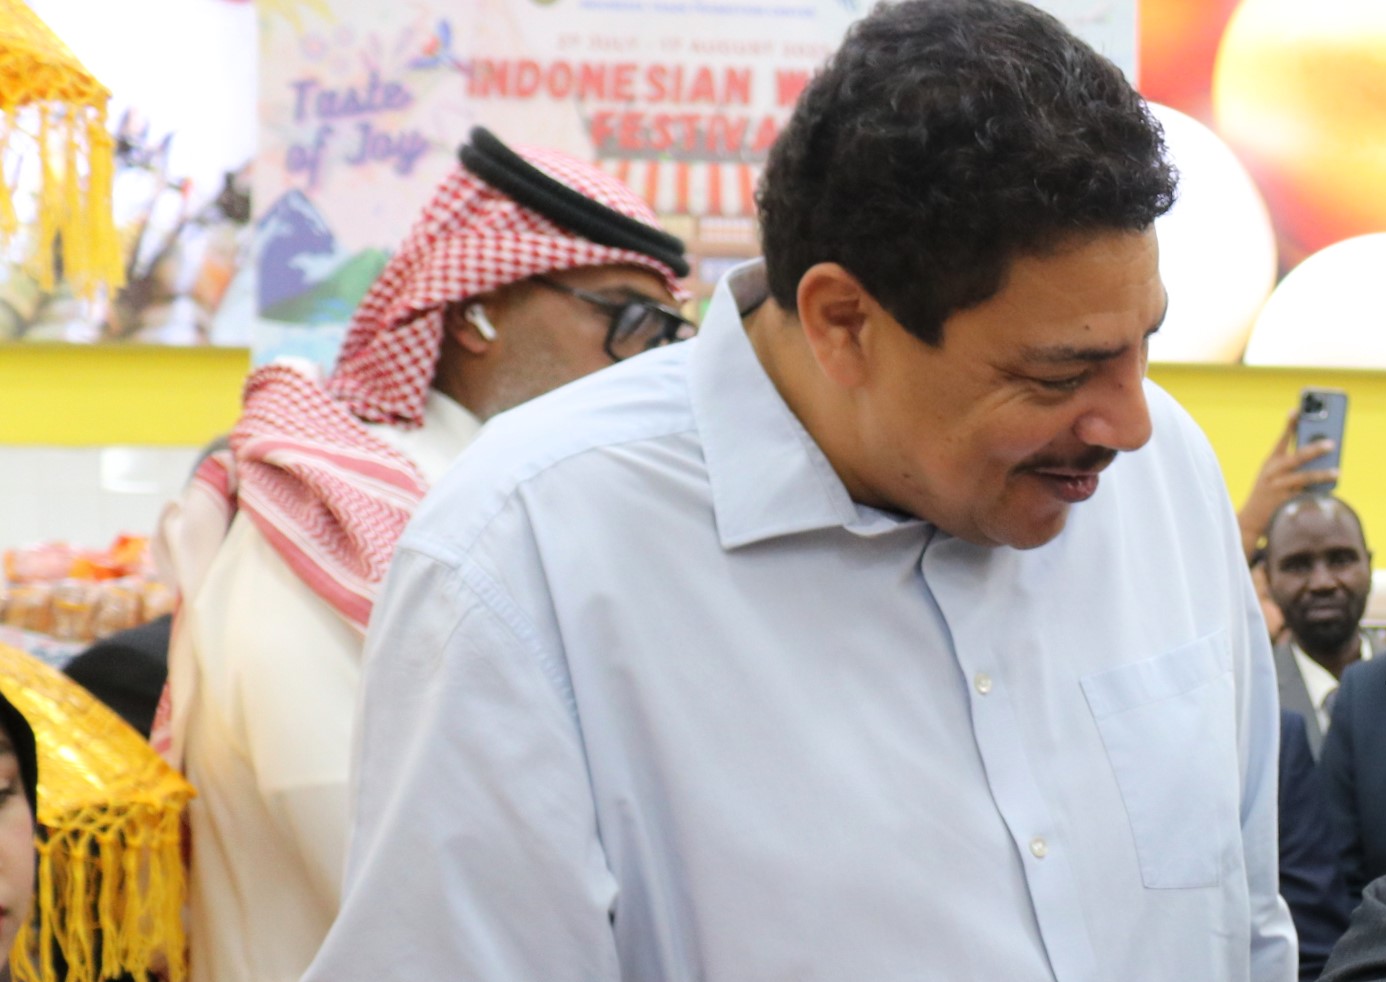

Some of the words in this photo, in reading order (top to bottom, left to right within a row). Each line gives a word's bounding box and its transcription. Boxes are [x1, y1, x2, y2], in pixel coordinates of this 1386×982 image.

[288, 71, 415, 124] Taste
[465, 57, 752, 106] INDONESIAN
[284, 125, 334, 188] of
[345, 121, 430, 177] Joy
